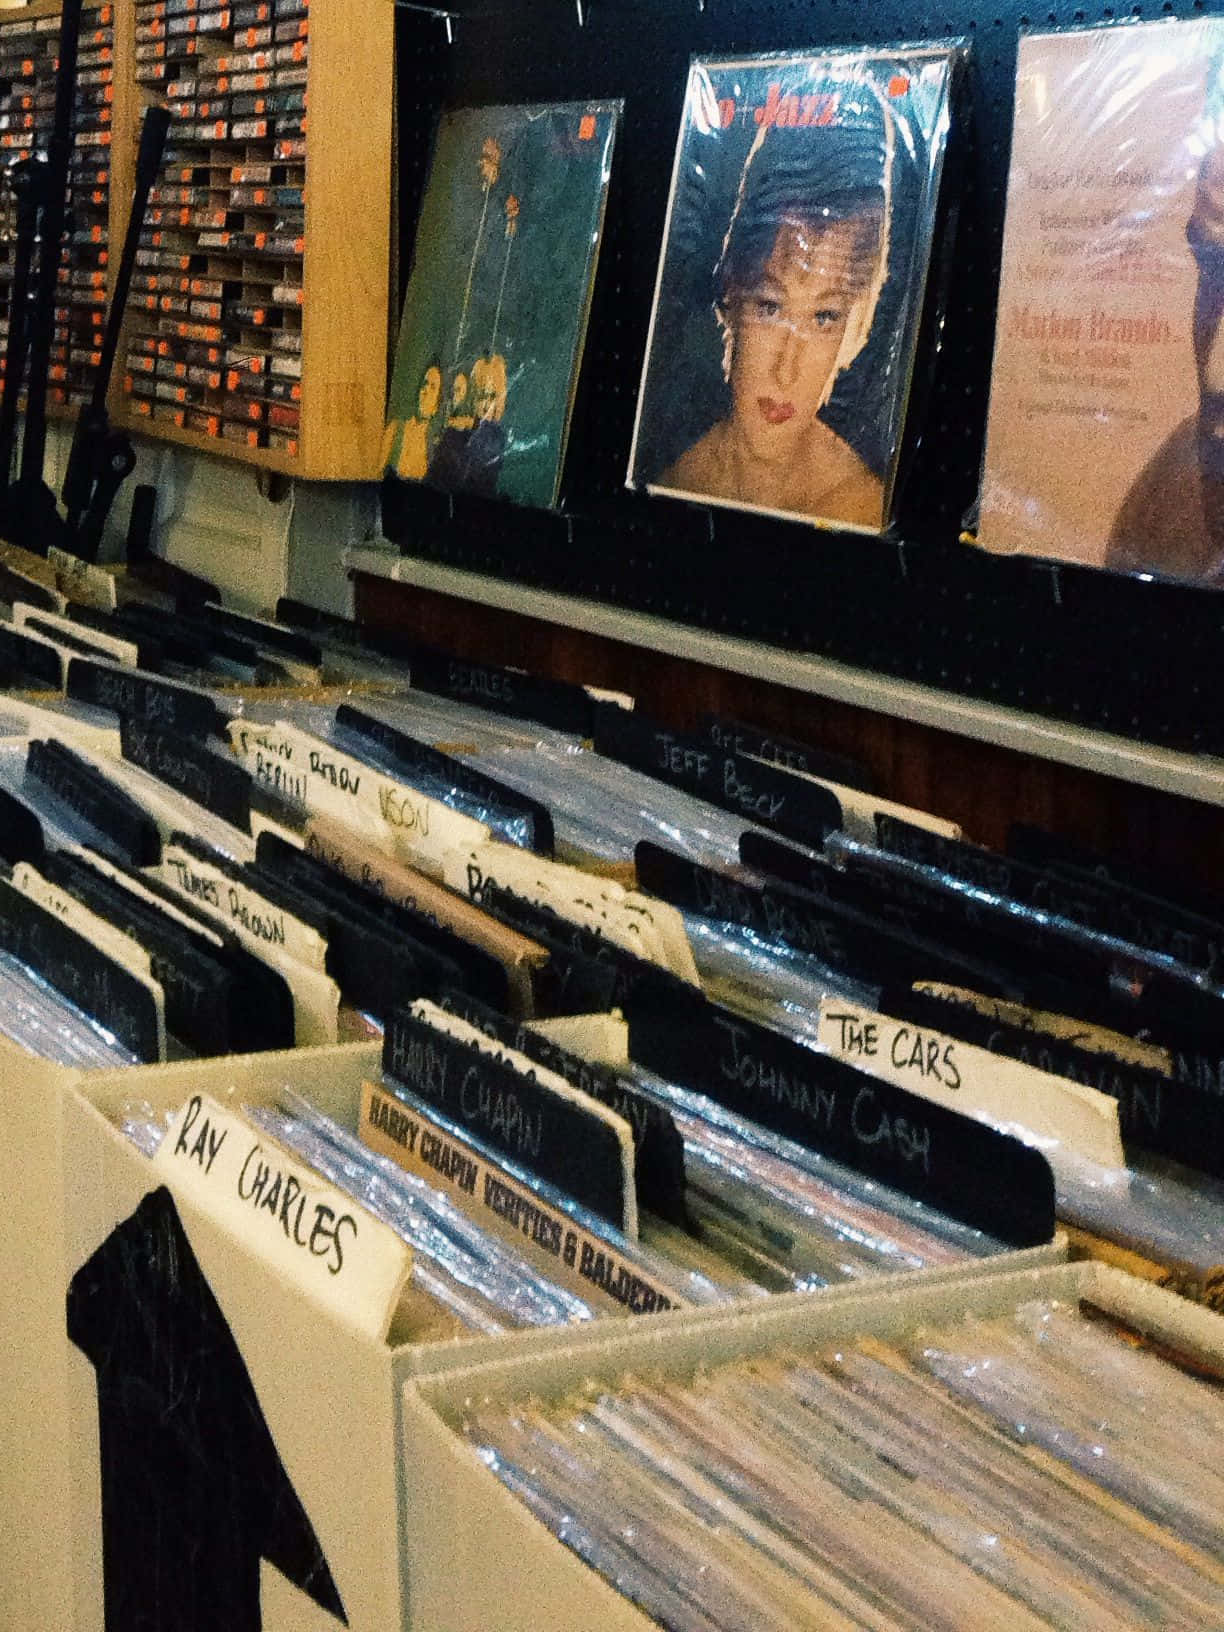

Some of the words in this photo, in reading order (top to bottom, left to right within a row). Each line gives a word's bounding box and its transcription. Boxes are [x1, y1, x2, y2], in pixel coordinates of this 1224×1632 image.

[654, 732, 711, 780] JEFF
[391, 1024, 449, 1100] HARRY
[459, 1065, 543, 1158] CHAPIN
[713, 1015, 838, 1122] JOHNNY
[825, 1013, 878, 1056] THE
[890, 1028, 962, 1089] CARS
[174, 1095, 225, 1176] RAY
[237, 1143, 358, 1276] CHARLES
[368, 1095, 420, 1153] HARRY
[419, 1130, 479, 1196] CHAPIN
